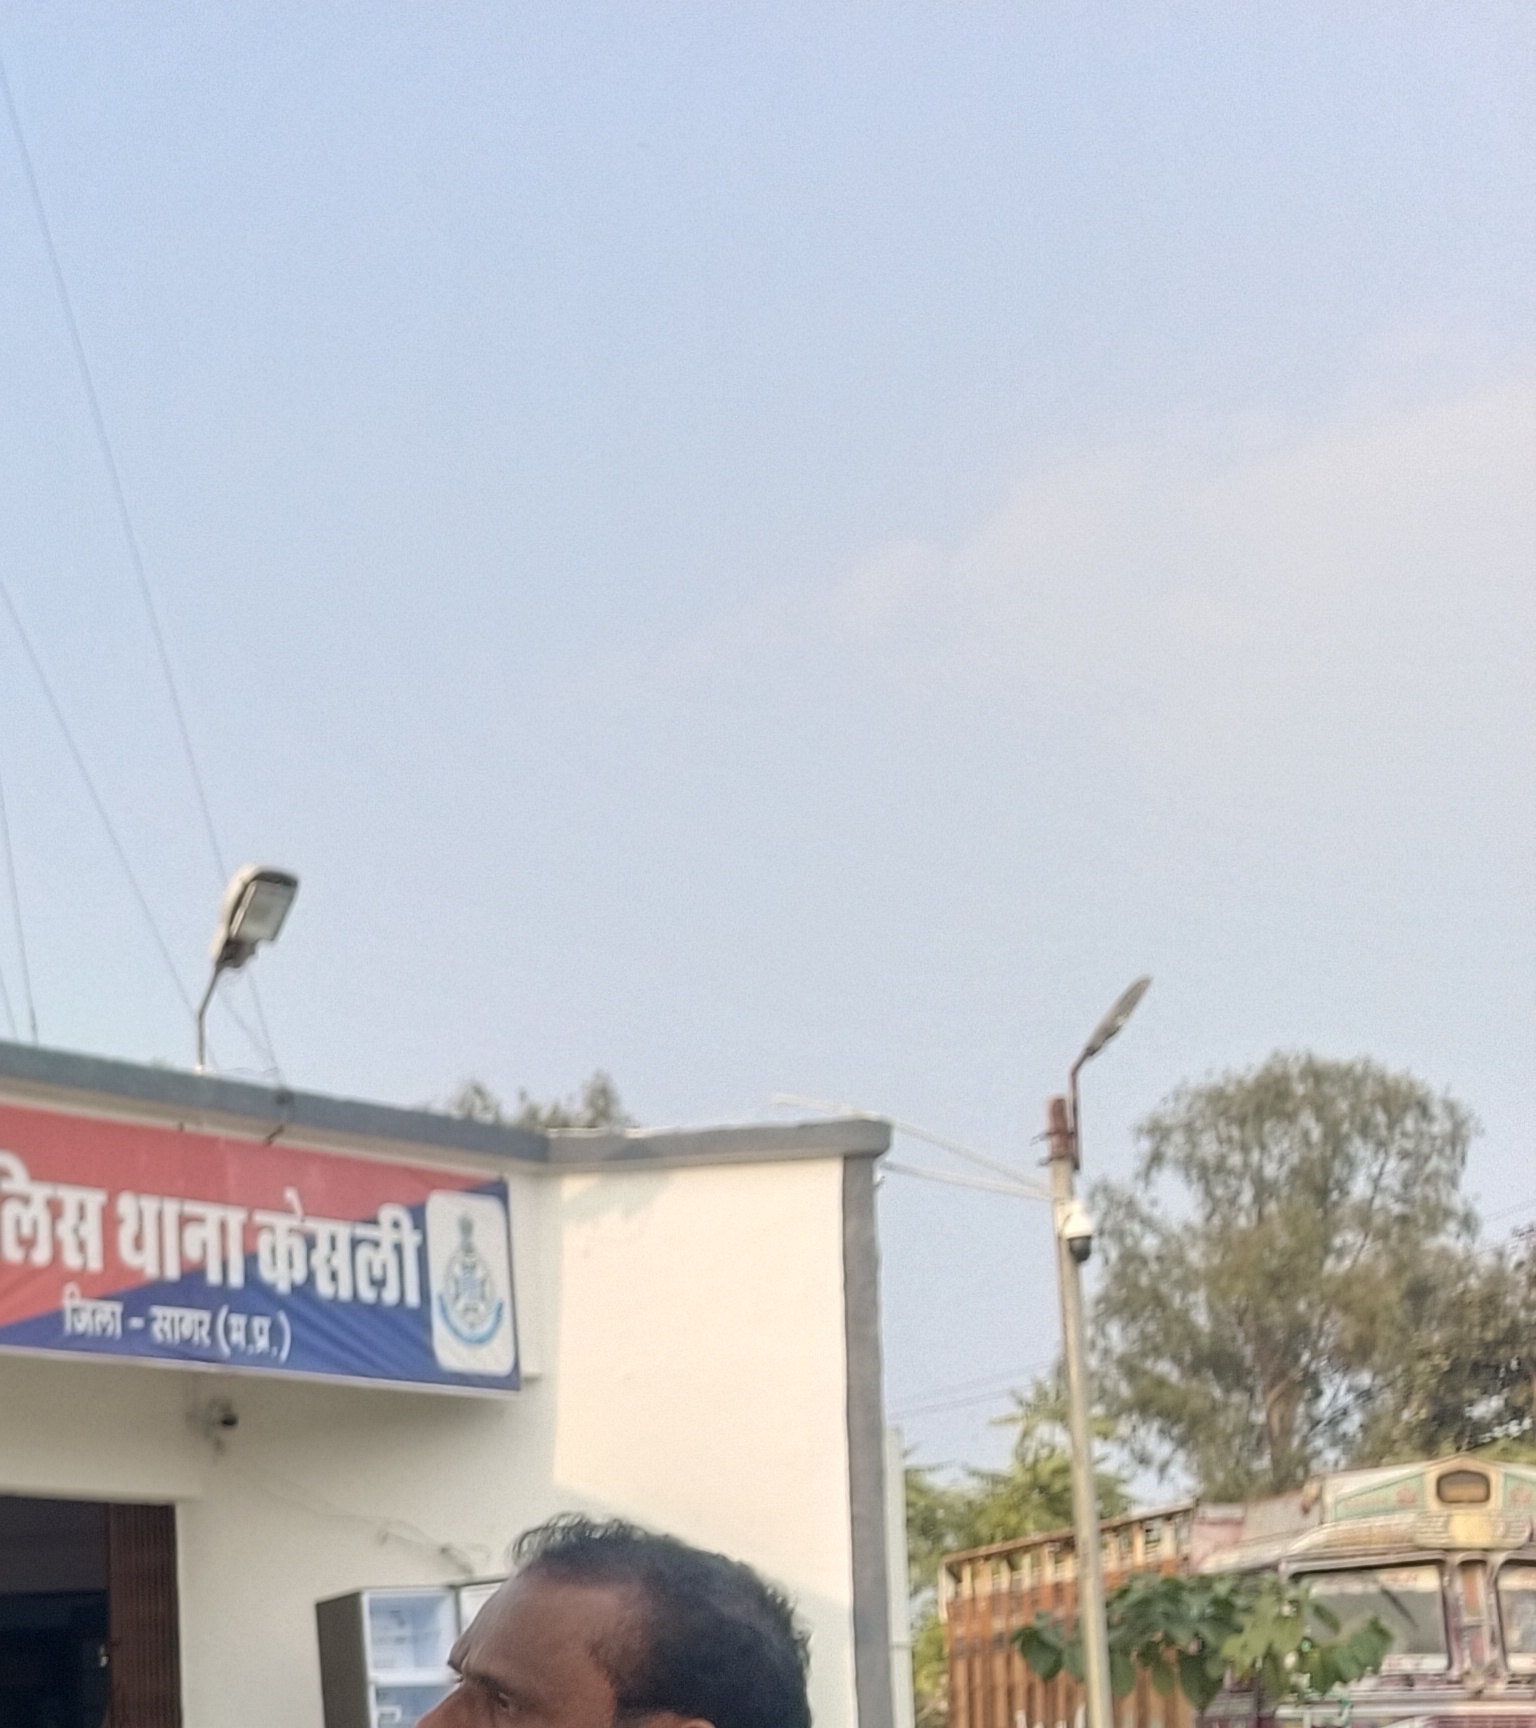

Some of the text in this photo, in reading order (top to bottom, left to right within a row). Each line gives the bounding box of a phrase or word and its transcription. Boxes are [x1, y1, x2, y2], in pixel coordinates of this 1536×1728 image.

[117, 1189, 248, 1289] थाना
[253, 1186, 423, 1309] केसली
[63, 1281, 124, 1341] जिला
[149, 1304, 212, 1348] सागर
